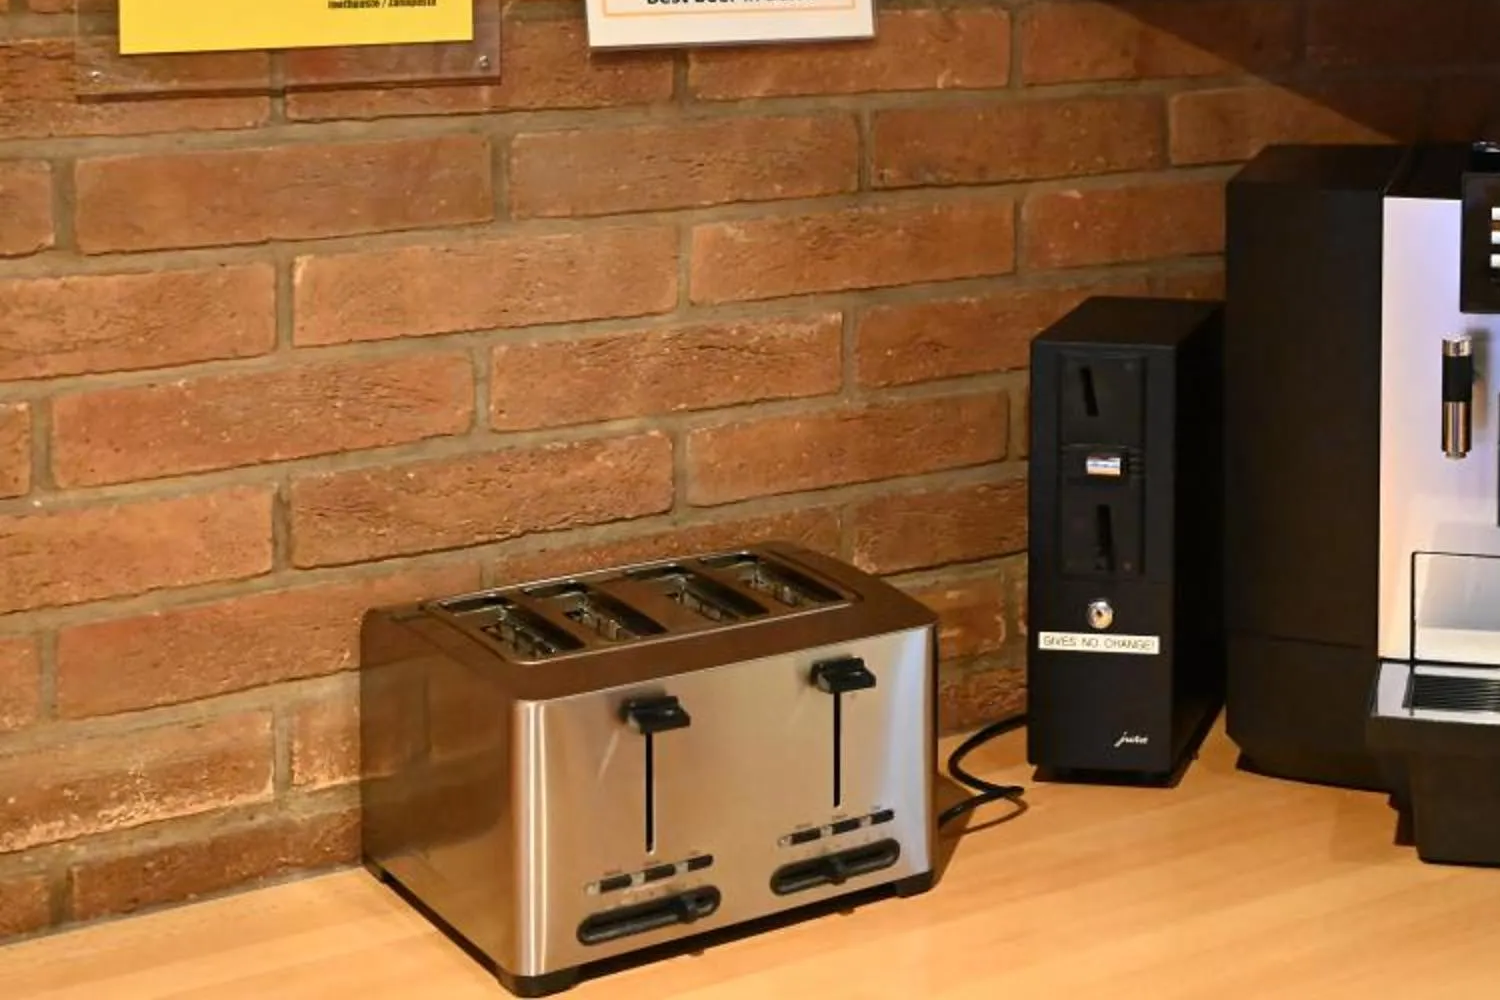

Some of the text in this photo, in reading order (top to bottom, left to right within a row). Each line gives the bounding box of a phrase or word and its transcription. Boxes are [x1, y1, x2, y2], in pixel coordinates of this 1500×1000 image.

[1043, 635, 1076, 647] GIVES
[1082, 637, 1099, 649] NO
[1113, 731, 1149, 748] jura
